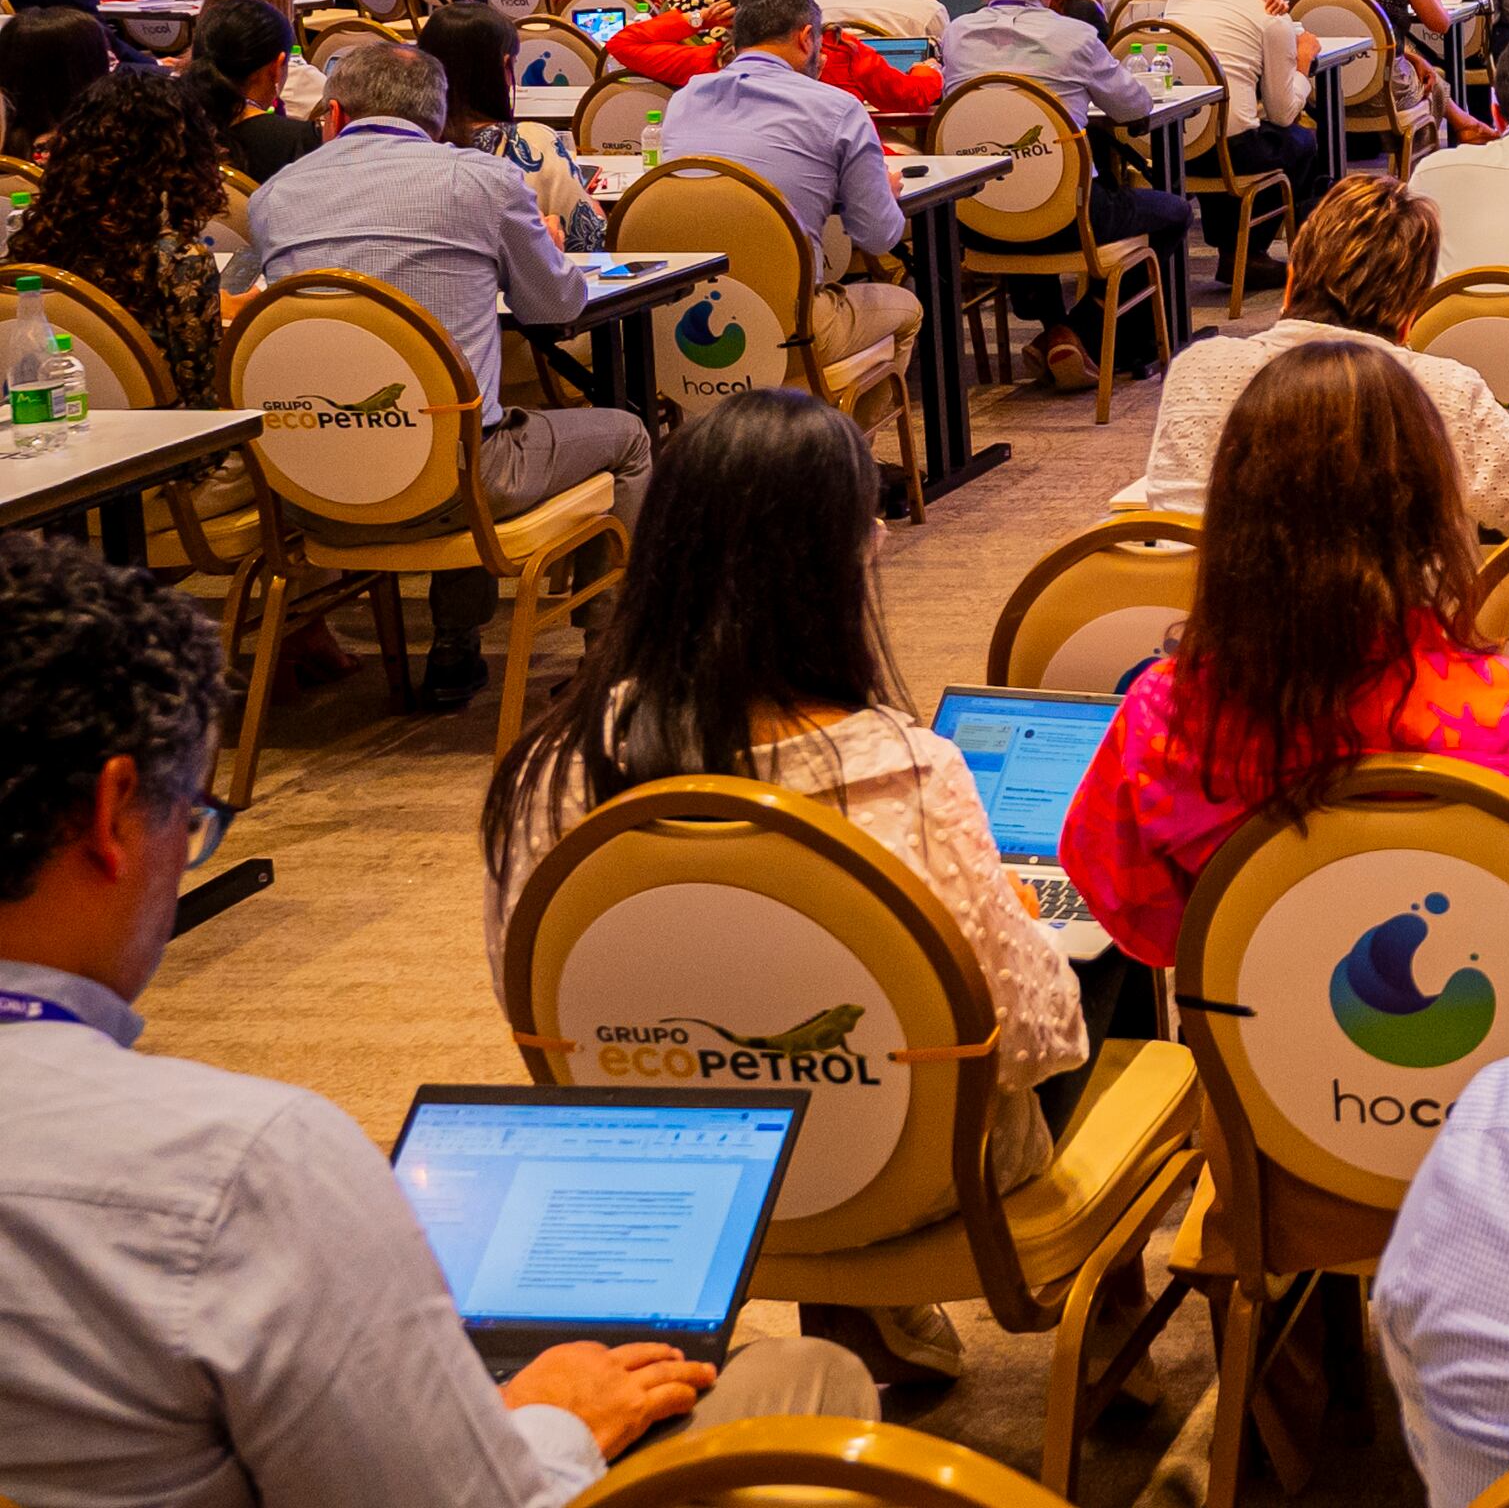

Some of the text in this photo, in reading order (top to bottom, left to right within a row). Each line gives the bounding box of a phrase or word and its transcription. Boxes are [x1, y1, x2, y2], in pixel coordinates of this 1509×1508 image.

[682, 375, 752, 395] hocol
[263, 401, 313, 411] GRUPO
[596, 1025, 689, 1045] GRUPO
